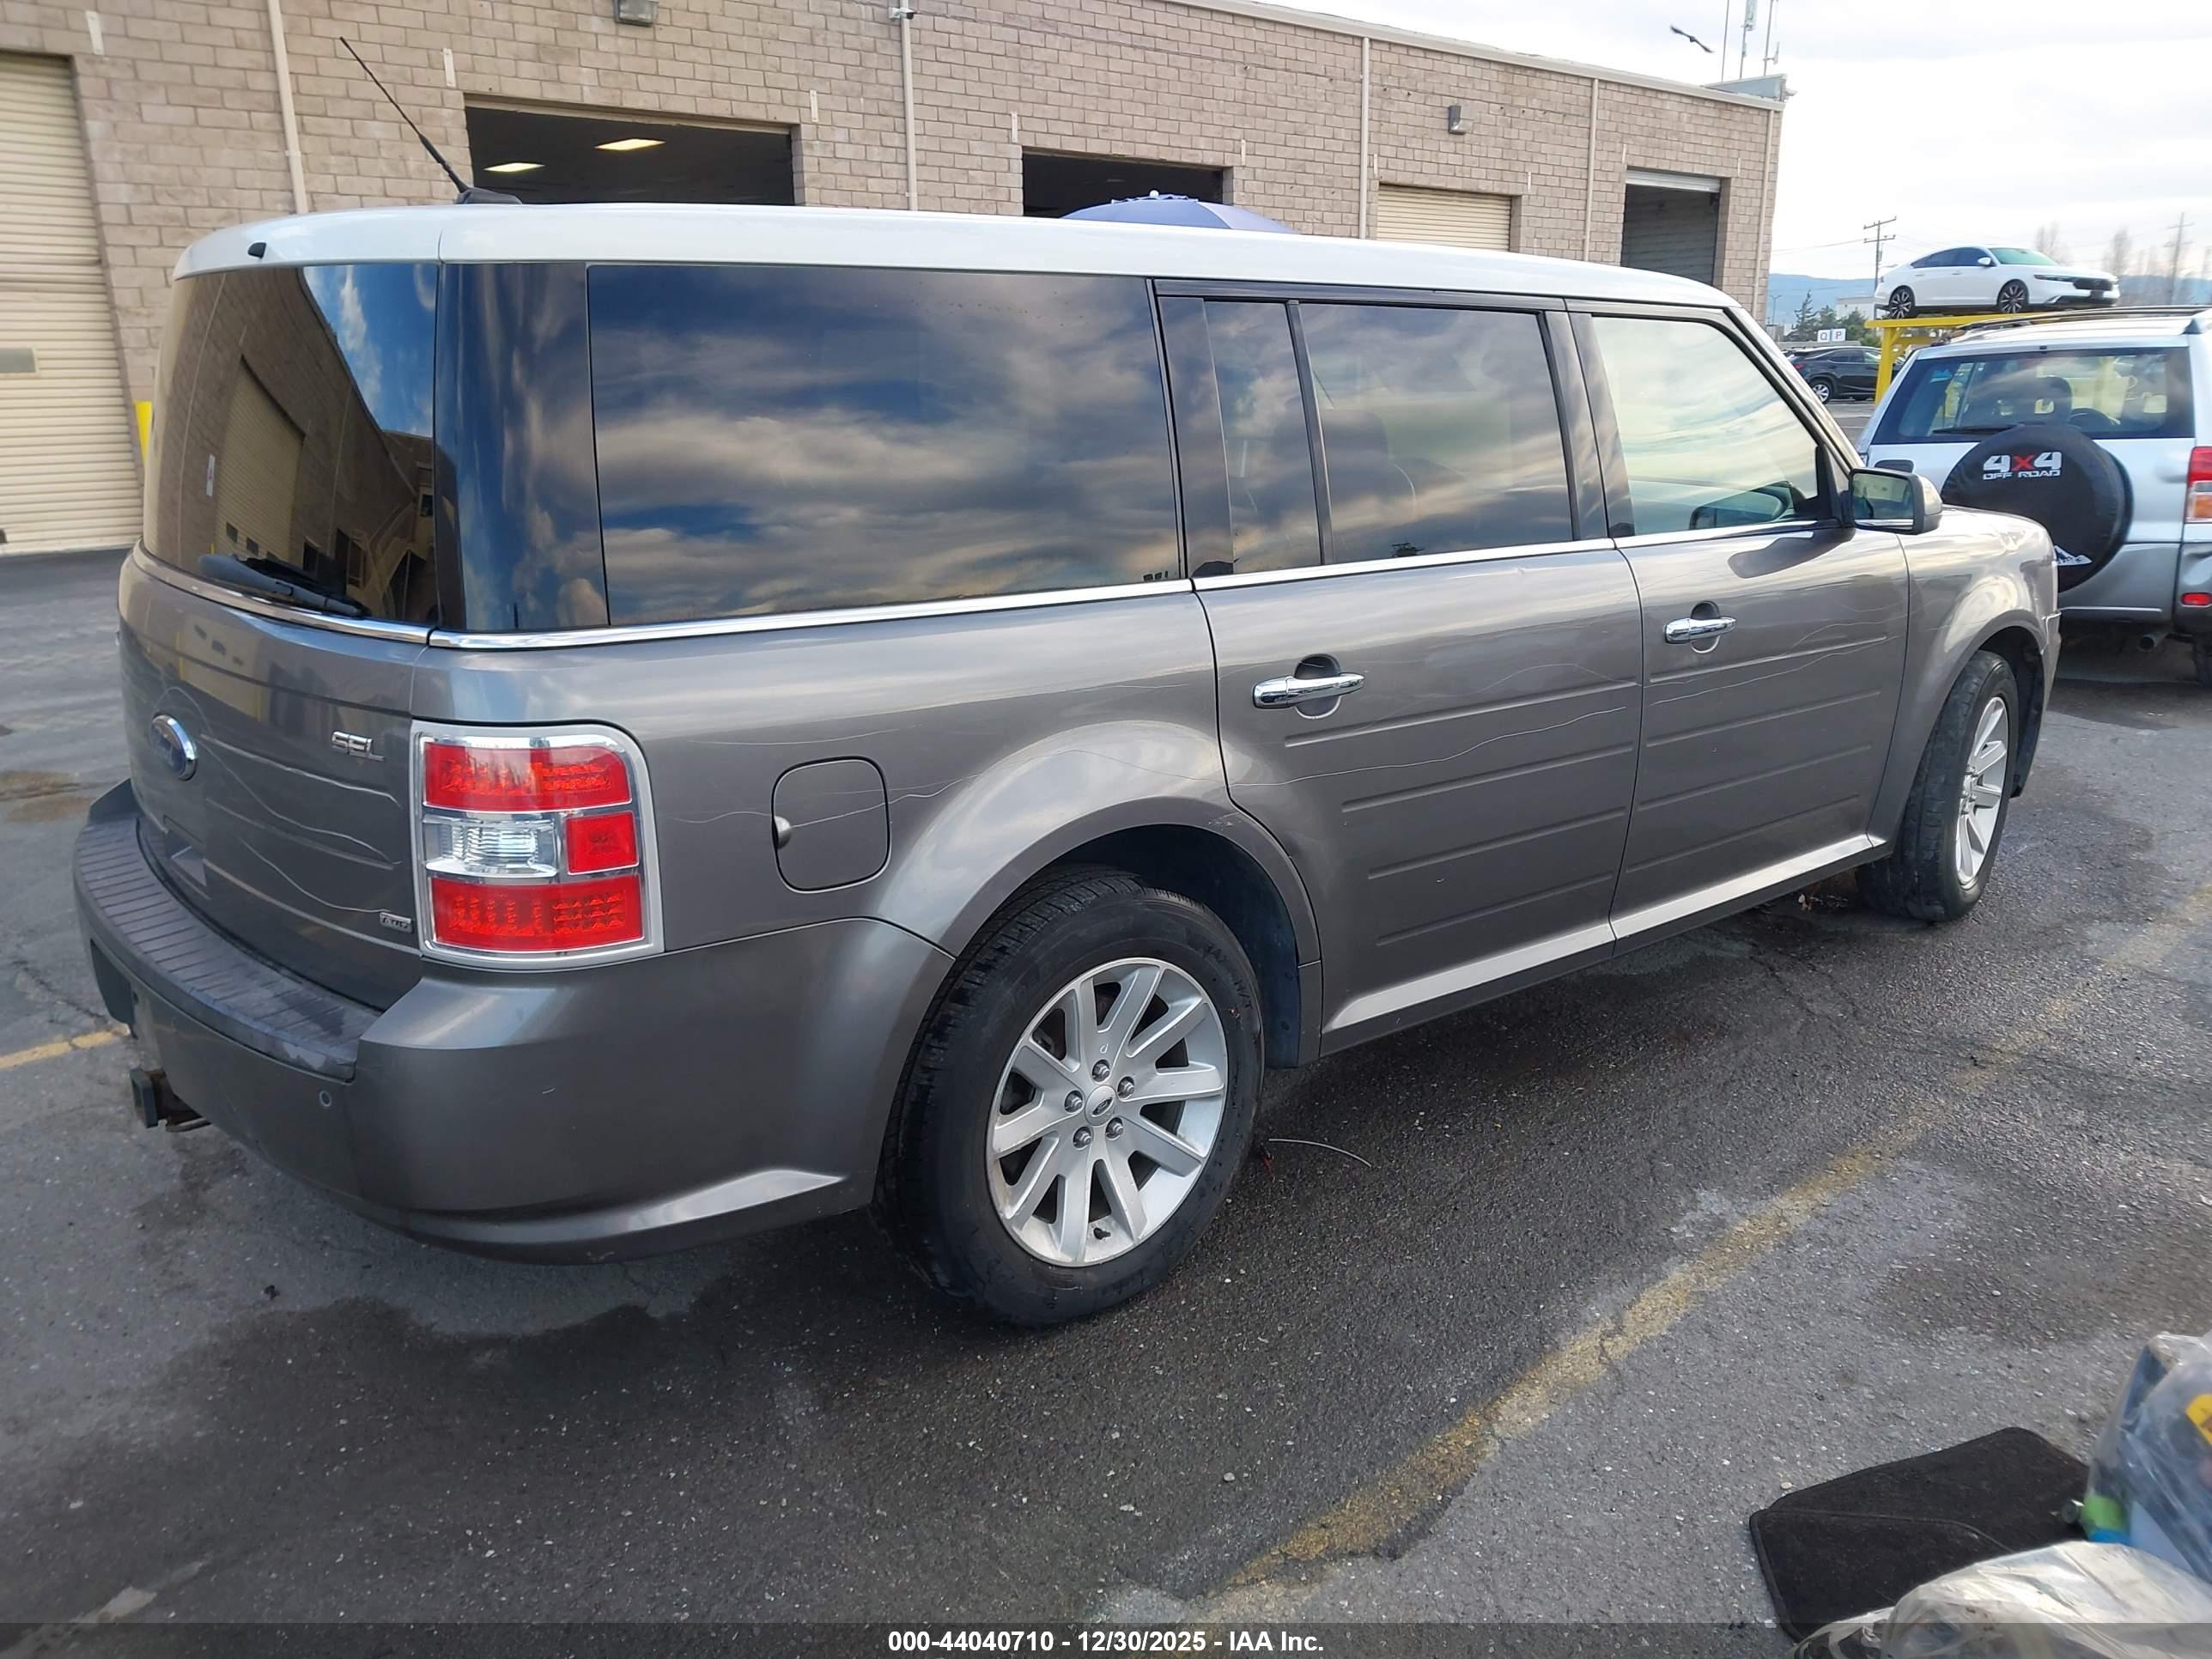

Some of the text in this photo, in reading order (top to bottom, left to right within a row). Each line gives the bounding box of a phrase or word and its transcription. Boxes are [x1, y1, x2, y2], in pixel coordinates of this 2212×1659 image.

[1983, 470, 2061, 480] OFF ROAD
[331, 730, 386, 763] SEL
